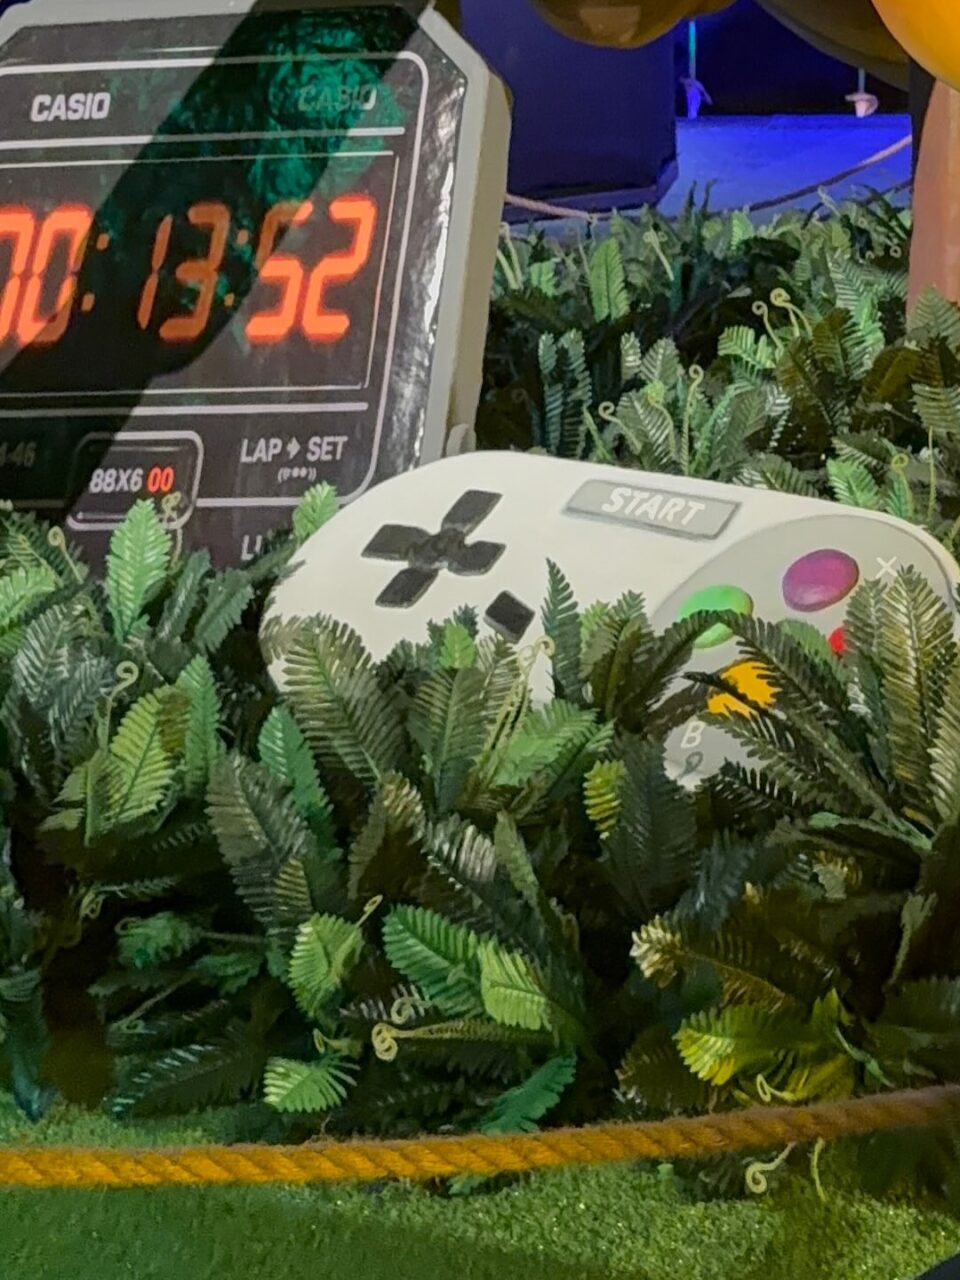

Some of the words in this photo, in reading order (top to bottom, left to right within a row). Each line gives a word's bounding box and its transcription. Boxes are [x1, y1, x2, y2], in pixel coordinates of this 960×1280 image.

[30, 92, 111, 122] CASIO
[298, 84, 378, 111] CASIO
[240, 438, 283, 463] LAP
[306, 436, 348, 461] SET
[147, 466, 174, 493] 00
[601, 487, 705, 525] START
[876, 556, 897, 579] X
[681, 720, 707, 748] B
